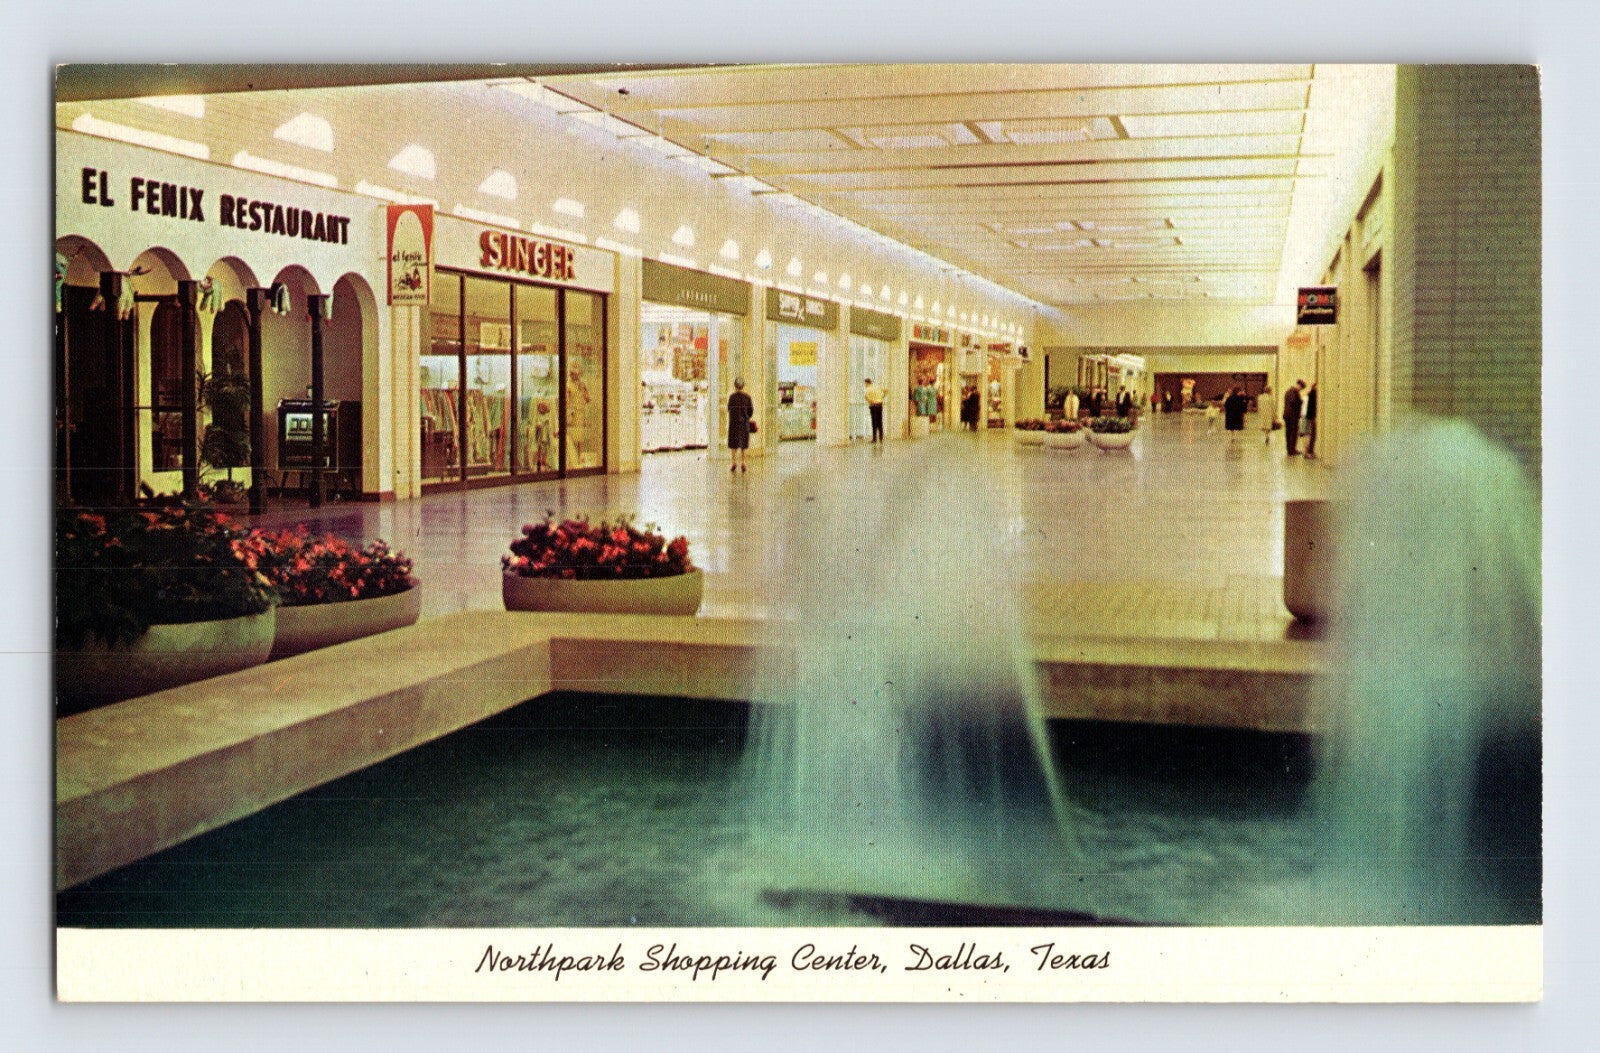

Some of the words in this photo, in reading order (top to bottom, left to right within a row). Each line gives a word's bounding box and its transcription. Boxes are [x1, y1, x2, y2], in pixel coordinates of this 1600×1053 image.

[82, 168, 115, 208] EL
[132, 178, 205, 222] FENIX
[221, 195, 350, 245] RESTAURANT
[480, 230, 577, 280] SINGER
